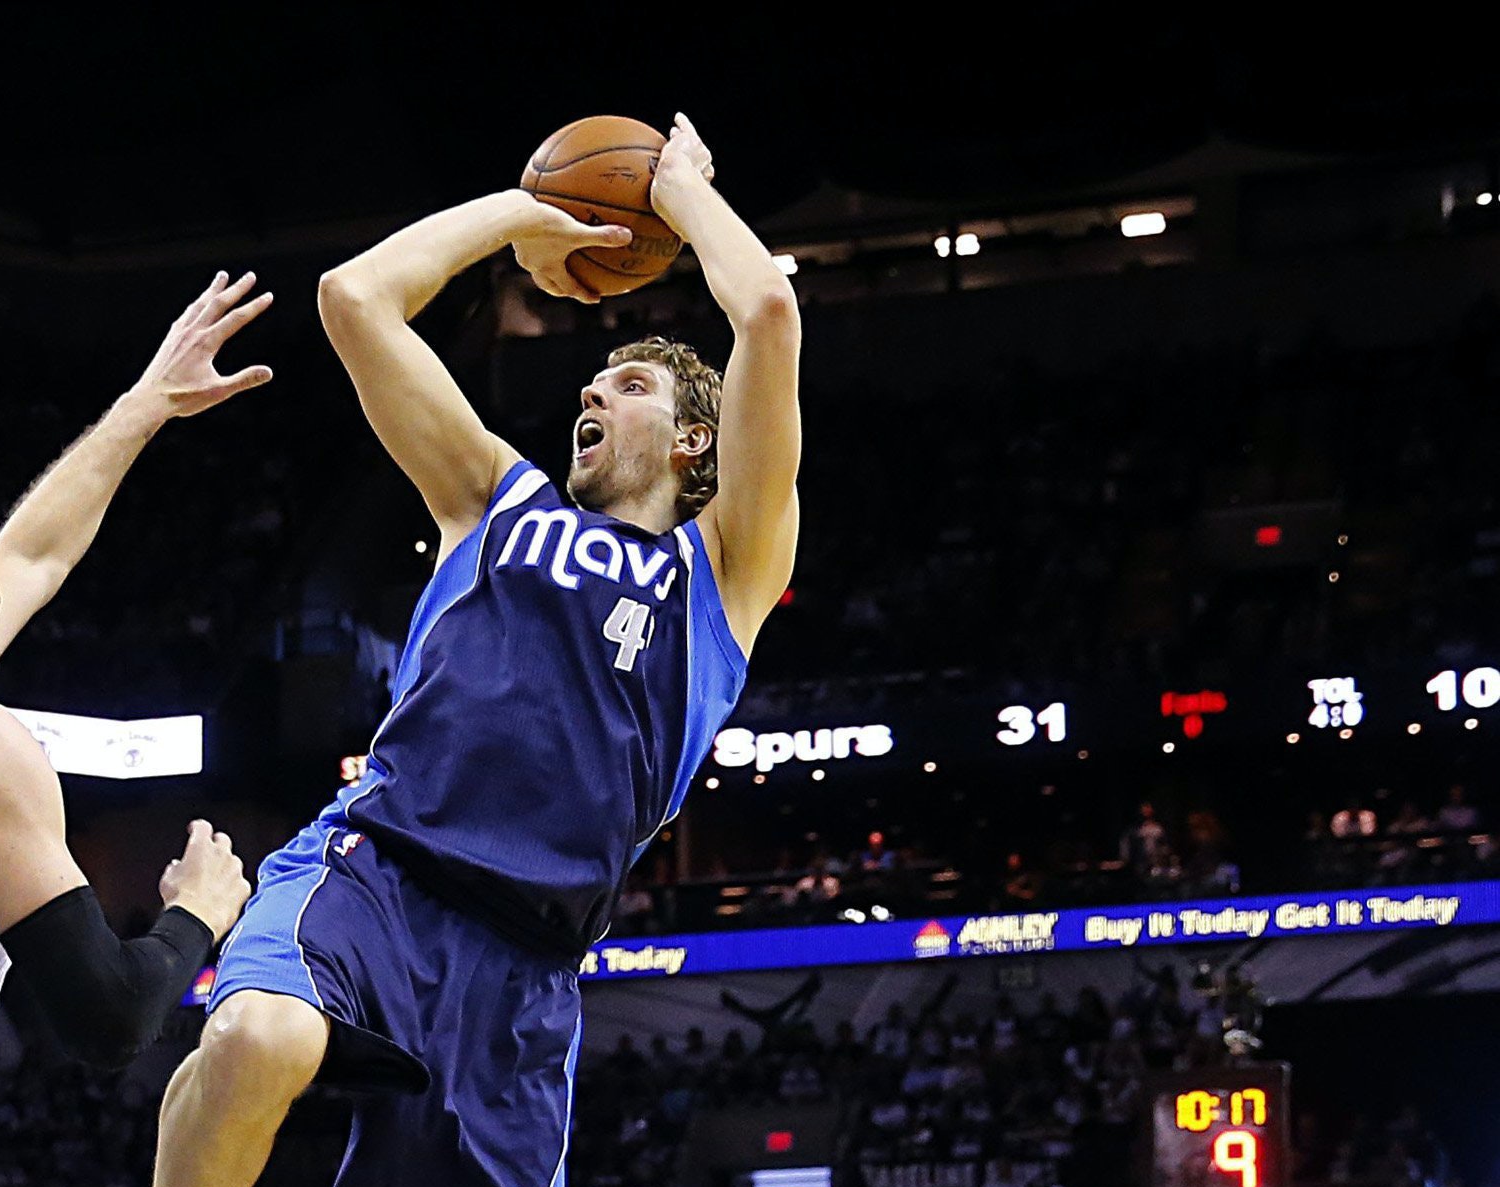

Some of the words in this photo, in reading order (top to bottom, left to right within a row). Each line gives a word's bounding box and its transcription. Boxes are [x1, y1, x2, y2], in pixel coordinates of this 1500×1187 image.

[603, 597, 655, 672] 4
[997, 702, 1066, 745] 31
[713, 725, 894, 772] Spurs
[1085, 915, 1144, 946] Buy
[1148, 911, 1175, 938] It
[1179, 906, 1269, 938] Today
[1275, 902, 1331, 930] Get
[1335, 899, 1363, 926] It
[1366, 894, 1461, 926] Today
[601, 945, 688, 975] Today
[1177, 1087, 1266, 1132] 10:17
